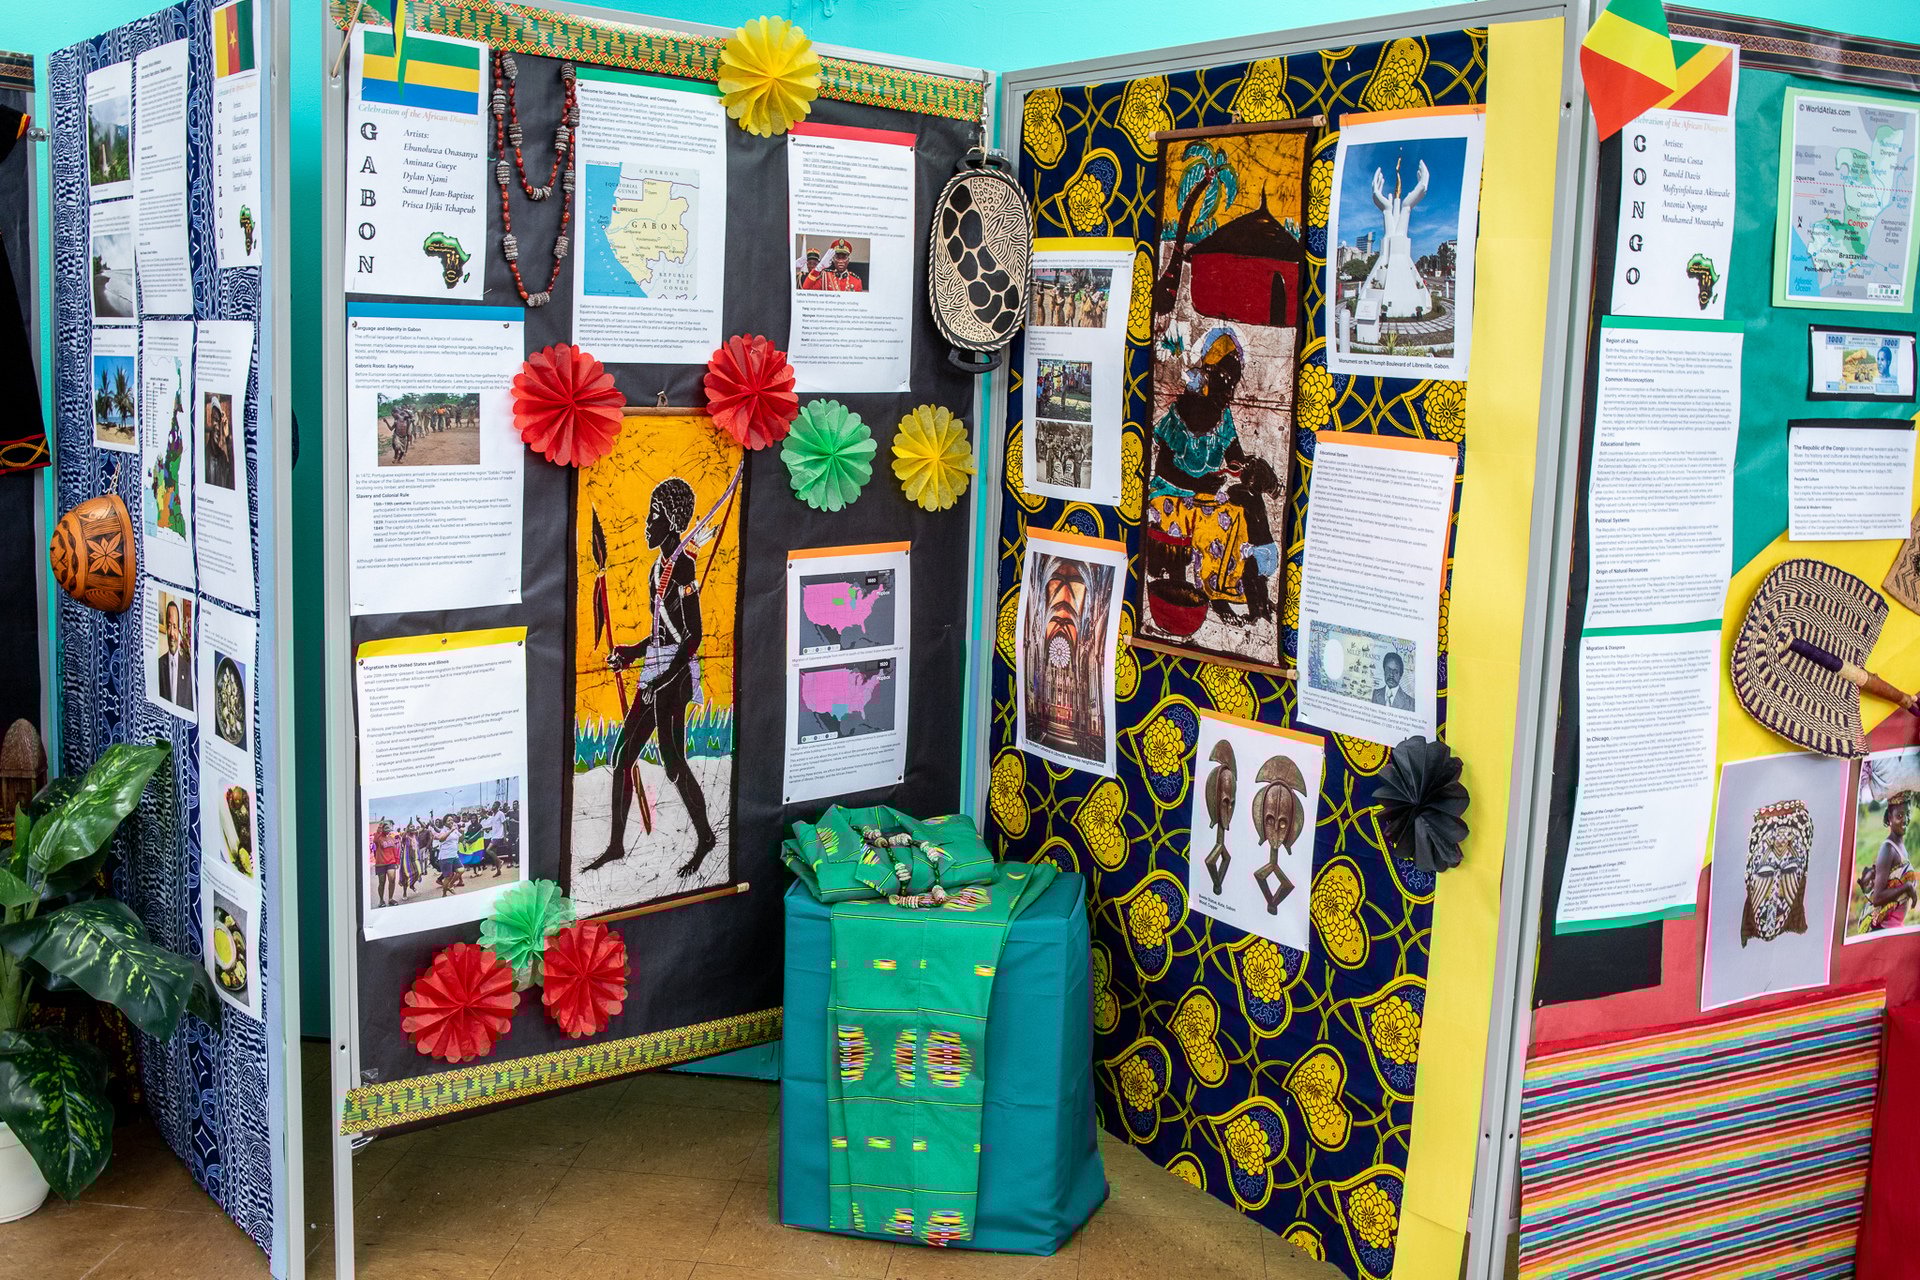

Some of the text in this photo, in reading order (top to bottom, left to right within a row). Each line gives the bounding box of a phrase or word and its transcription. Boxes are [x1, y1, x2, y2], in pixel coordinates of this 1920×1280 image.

[358, 104, 399, 116] Celebration
[401, 109, 408, 118] of
[409, 109, 421, 118] the
[422, 111, 447, 121] African
[1806, 105, 1850, 116] WorldAtlas.com
[1634, 117, 1664, 126] elebration
[404, 130, 429, 138] Artists:
[1663, 140, 1683, 148] Artists:
[444, 148, 478, 160] Onasanya
[1663, 154, 1703, 165] Martina Costa
[403, 158, 457, 172] Aminata Gueye
[403, 172, 447, 184] Dylan Njami
[1663, 169, 1700, 180] Ranold Davis
[358, 122, 378, 273] GABON
[402, 186, 474, 200] Samuel Jean-Baptiste
[402, 200, 423, 208] Prisca
[425, 202, 442, 212] Djiki
[1626, 135, 1646, 284] CONGO
[1662, 200, 1684, 208] Antonia
[632, 221, 677, 230] GABON
[1662, 215, 1723, 228] Mouhamed Moustapha
[1848, 220, 1868, 229] Congo
[1839, 252, 1868, 260] Brazzaville
[1828, 336, 1843, 344] 1000
[1884, 339, 1898, 347] 1000
